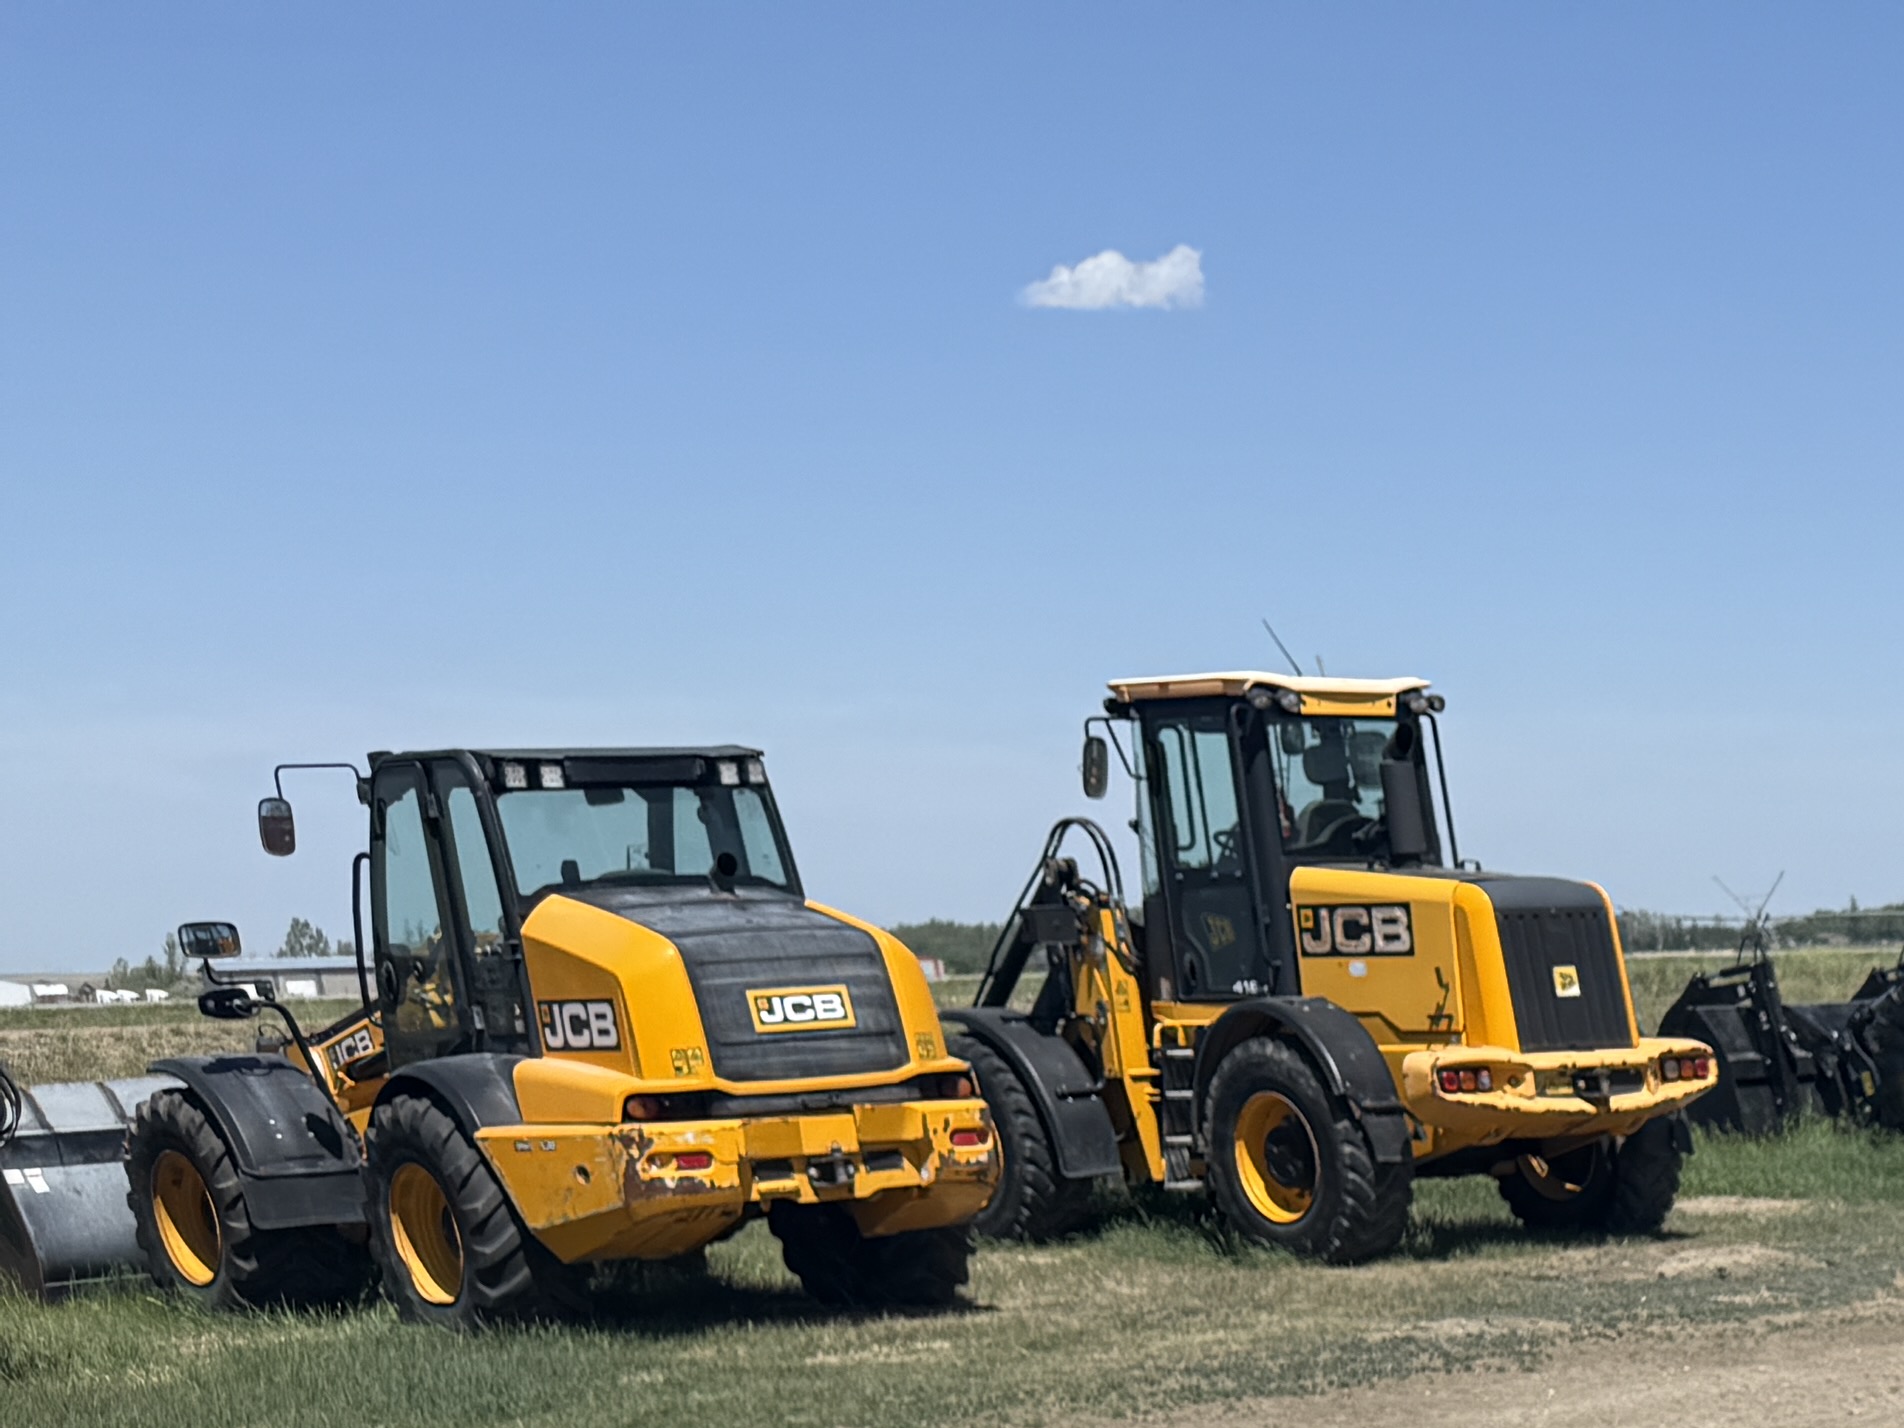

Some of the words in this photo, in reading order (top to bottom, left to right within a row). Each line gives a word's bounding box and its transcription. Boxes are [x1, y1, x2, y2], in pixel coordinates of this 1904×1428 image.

[1301, 906, 1412, 954] JCB
[542, 1002, 619, 1049] JCB
[759, 993, 846, 1024] JCB
[331, 1030, 375, 1068] JCB
